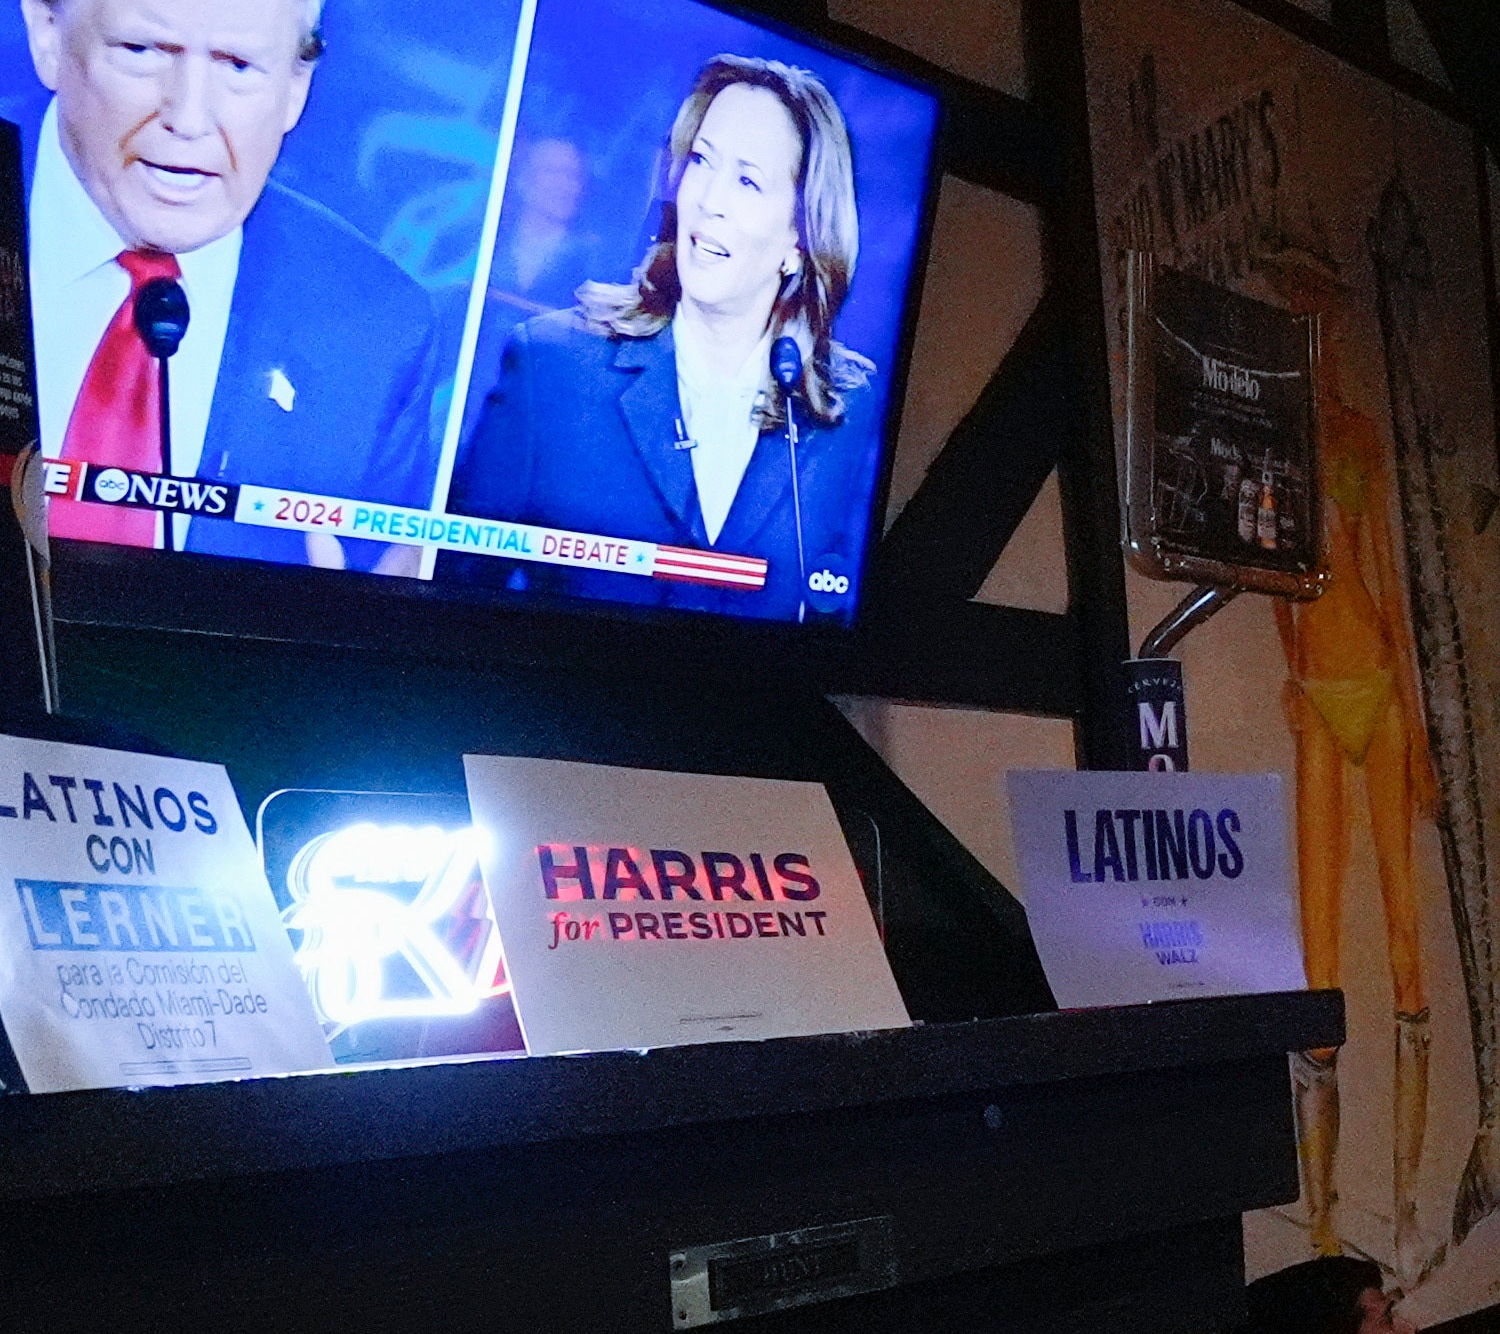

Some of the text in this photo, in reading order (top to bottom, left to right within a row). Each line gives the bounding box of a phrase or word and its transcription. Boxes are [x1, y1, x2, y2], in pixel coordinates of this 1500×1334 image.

[128, 474, 228, 514] NEWS
[274, 497, 628, 566] 2024 PRESIDENTIAL DEBATE
[808, 569, 850, 595] abc
[86, 834, 156, 875] CON
[1063, 808, 1245, 883] LATINOS
[537, 844, 822, 902] HARRIS
[22, 886, 251, 949] LERNER
[548, 910, 828, 950] for PRESIDENT
[58, 957, 249, 990] para la Comisión del
[1156, 949, 1201, 966] WALZ
[60, 988, 268, 1020] Condado Miami-Dade
[137, 1021, 218, 1050] Distrito 7
